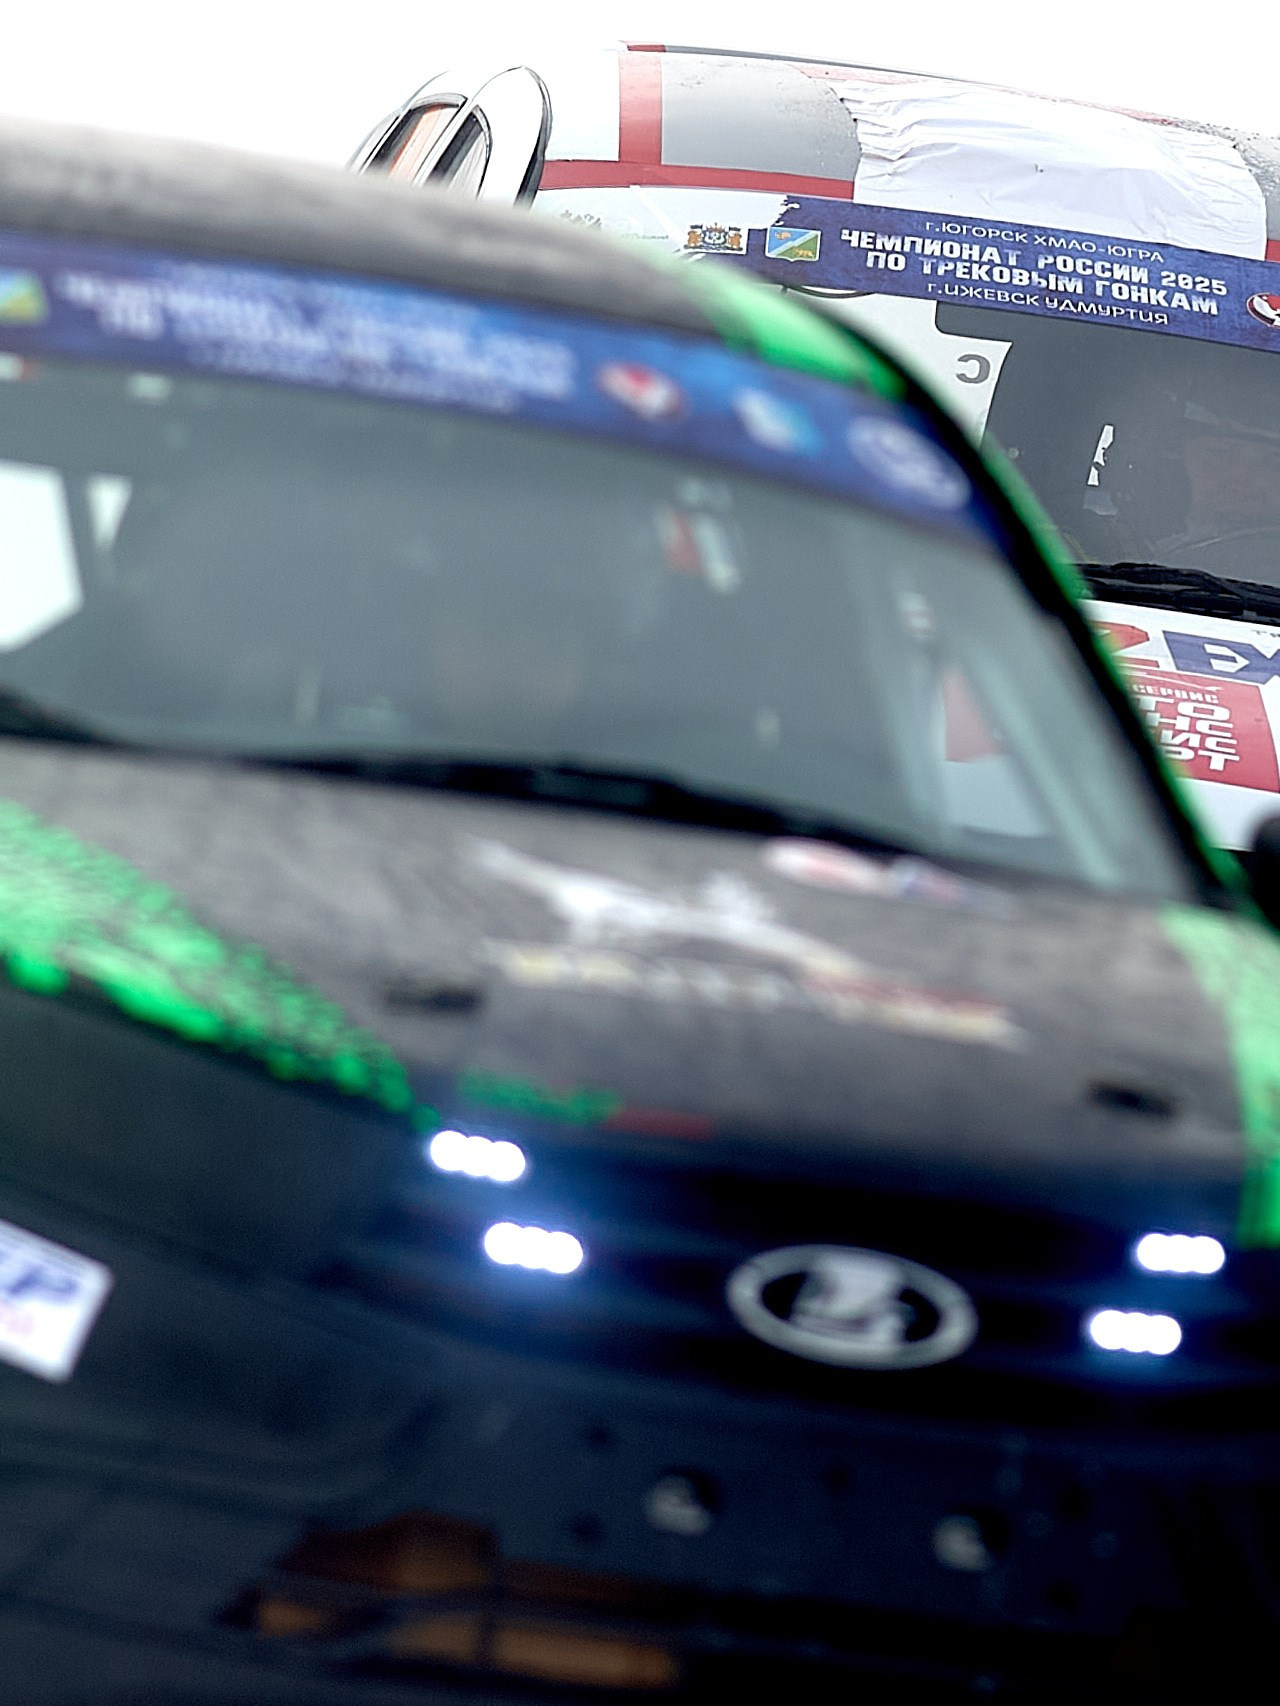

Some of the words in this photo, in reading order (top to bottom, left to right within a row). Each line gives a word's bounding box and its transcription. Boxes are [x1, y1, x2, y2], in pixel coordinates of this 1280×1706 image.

[840, 229, 1022, 266] ЧЕМПИОНАТ
[1037, 254, 1149, 284] РОССИИ
[1160, 271, 1227, 296] 2025
[1034, 234, 1164, 263] ХМАО-ЮГРА
[866, 251, 906, 271] ПО
[918, 257, 1083, 294] ТРЕКОВЫМ
[1095, 280, 1218, 315] ГОНКАМ
[1045, 297, 1168, 325] УДМУРТИЯ
